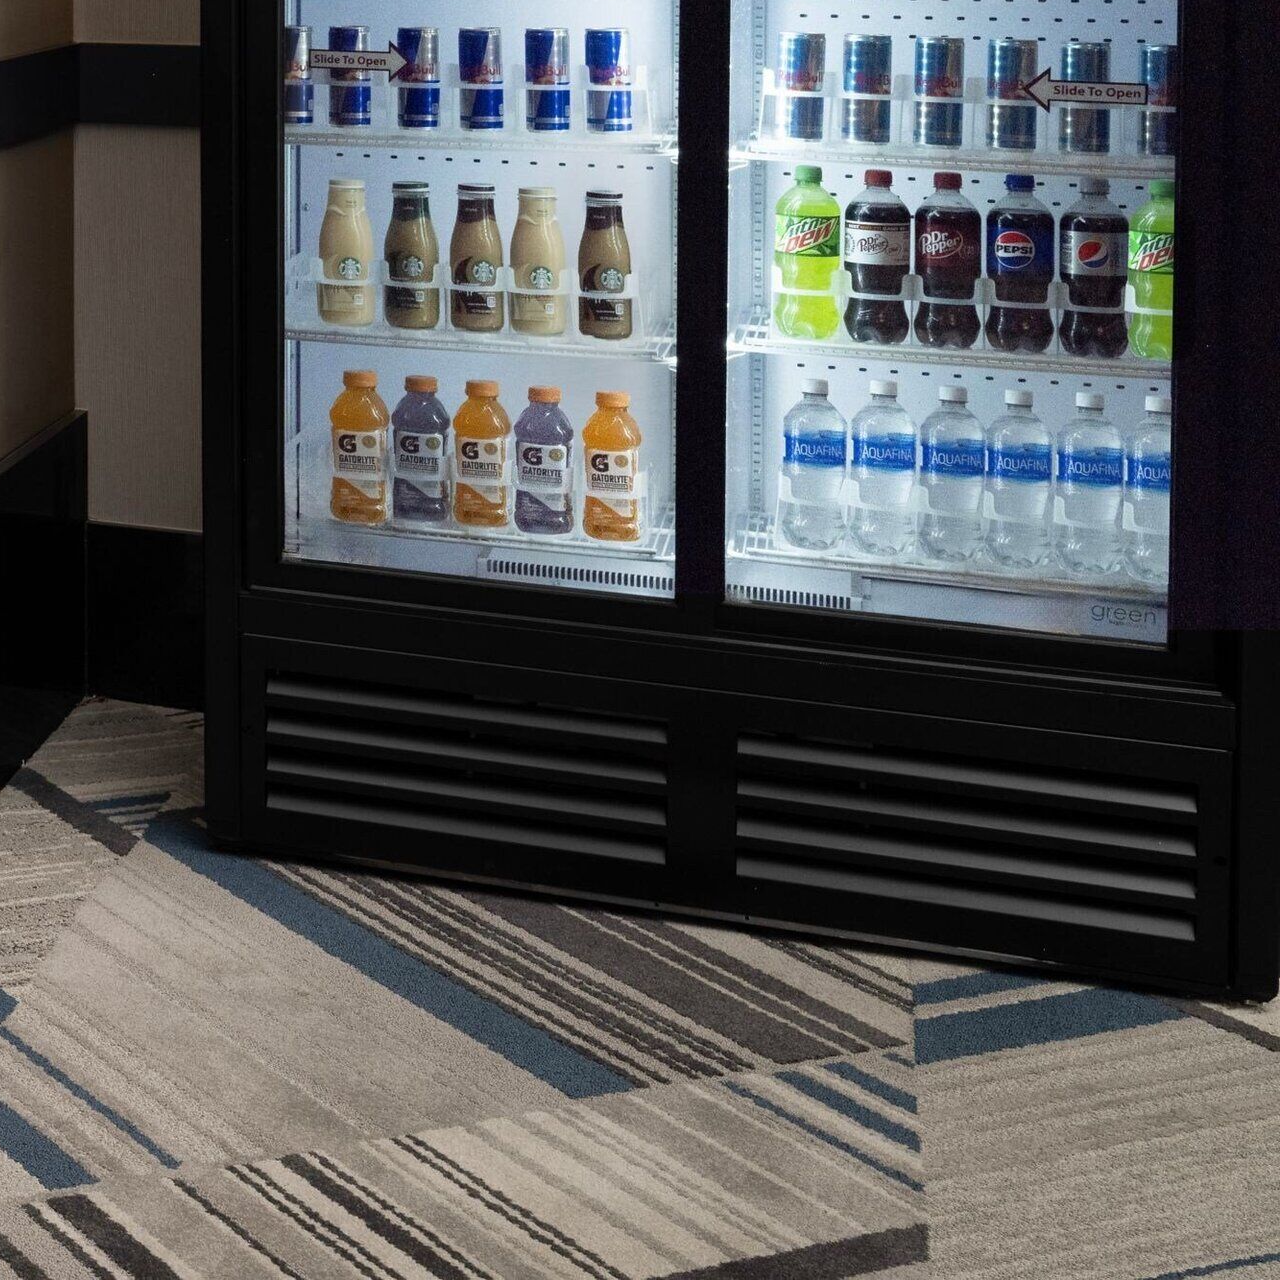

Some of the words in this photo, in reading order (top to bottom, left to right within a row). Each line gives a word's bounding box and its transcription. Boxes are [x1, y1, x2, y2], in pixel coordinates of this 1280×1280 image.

[313, 53, 340, 64] Slide
[343, 55, 354, 65] To
[357, 56, 387, 67] Open
[480, 64, 501, 76] Bull
[546, 64, 567, 76] Bull
[1052, 85, 1085, 97] Slide
[1088, 86, 1102, 97] To
[1105, 87, 1141, 100] Open
[867, 236, 878, 245] Dr
[920, 233, 960, 256] Pepper
[930, 231, 949, 243] Dr
[858, 238, 887, 253] Pepper
[995, 244, 1033, 255] PEPSI
[339, 434, 357, 454] G
[400, 435, 420, 454] G
[461, 441, 479, 460] G
[339, 454, 376, 465] GATORLYTE
[400, 454, 439, 466] GATORLYTE
[522, 447, 543, 466] G
[861, 445, 913, 463] AQUAFINA
[931, 452, 983, 468] AQUAFINA
[461, 460, 498, 471] GATORLYTE
[591, 453, 610, 473] G
[997, 457, 1049, 472] AQUAFINA
[1067, 460, 1121, 478] AQUAFINA
[522, 466, 563, 477] GATORLYTE
[591, 473, 629, 484] GATORLYTE
[1090, 604, 1157, 625] green
